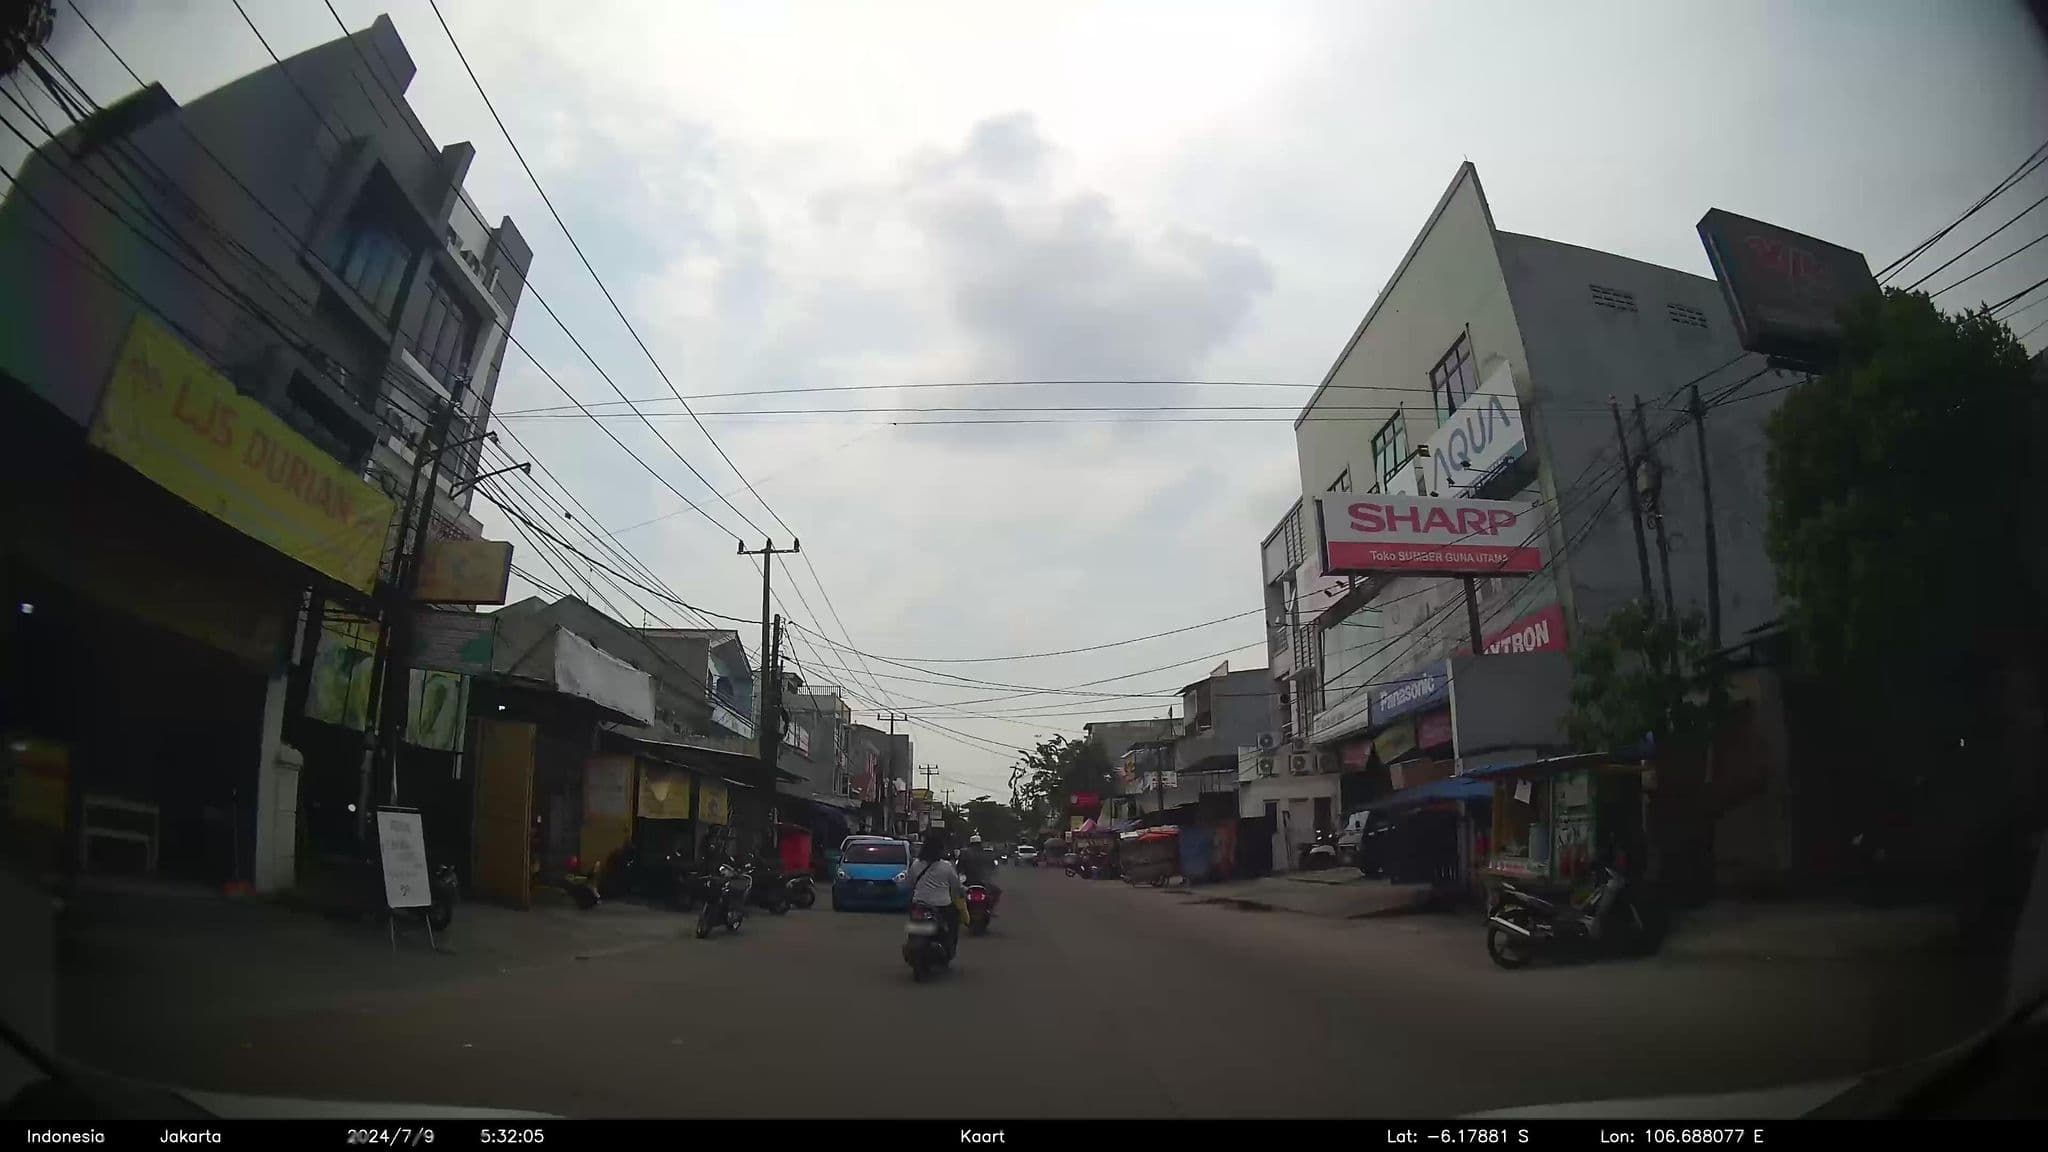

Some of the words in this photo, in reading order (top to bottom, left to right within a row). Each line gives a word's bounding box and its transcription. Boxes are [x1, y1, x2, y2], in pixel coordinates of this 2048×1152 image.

[1434, 395, 1511, 491] AQUA
[240, 424, 354, 523] DURIAN
[1347, 502, 1518, 537] SHARP
[1369, 549, 1396, 562] Toko
[1398, 550, 1443, 564] SUMBER
[1444, 551, 1475, 564] GUNA
[1475, 552, 1509, 565] UTAMA
[1379, 672, 1436, 711] Panasonic
